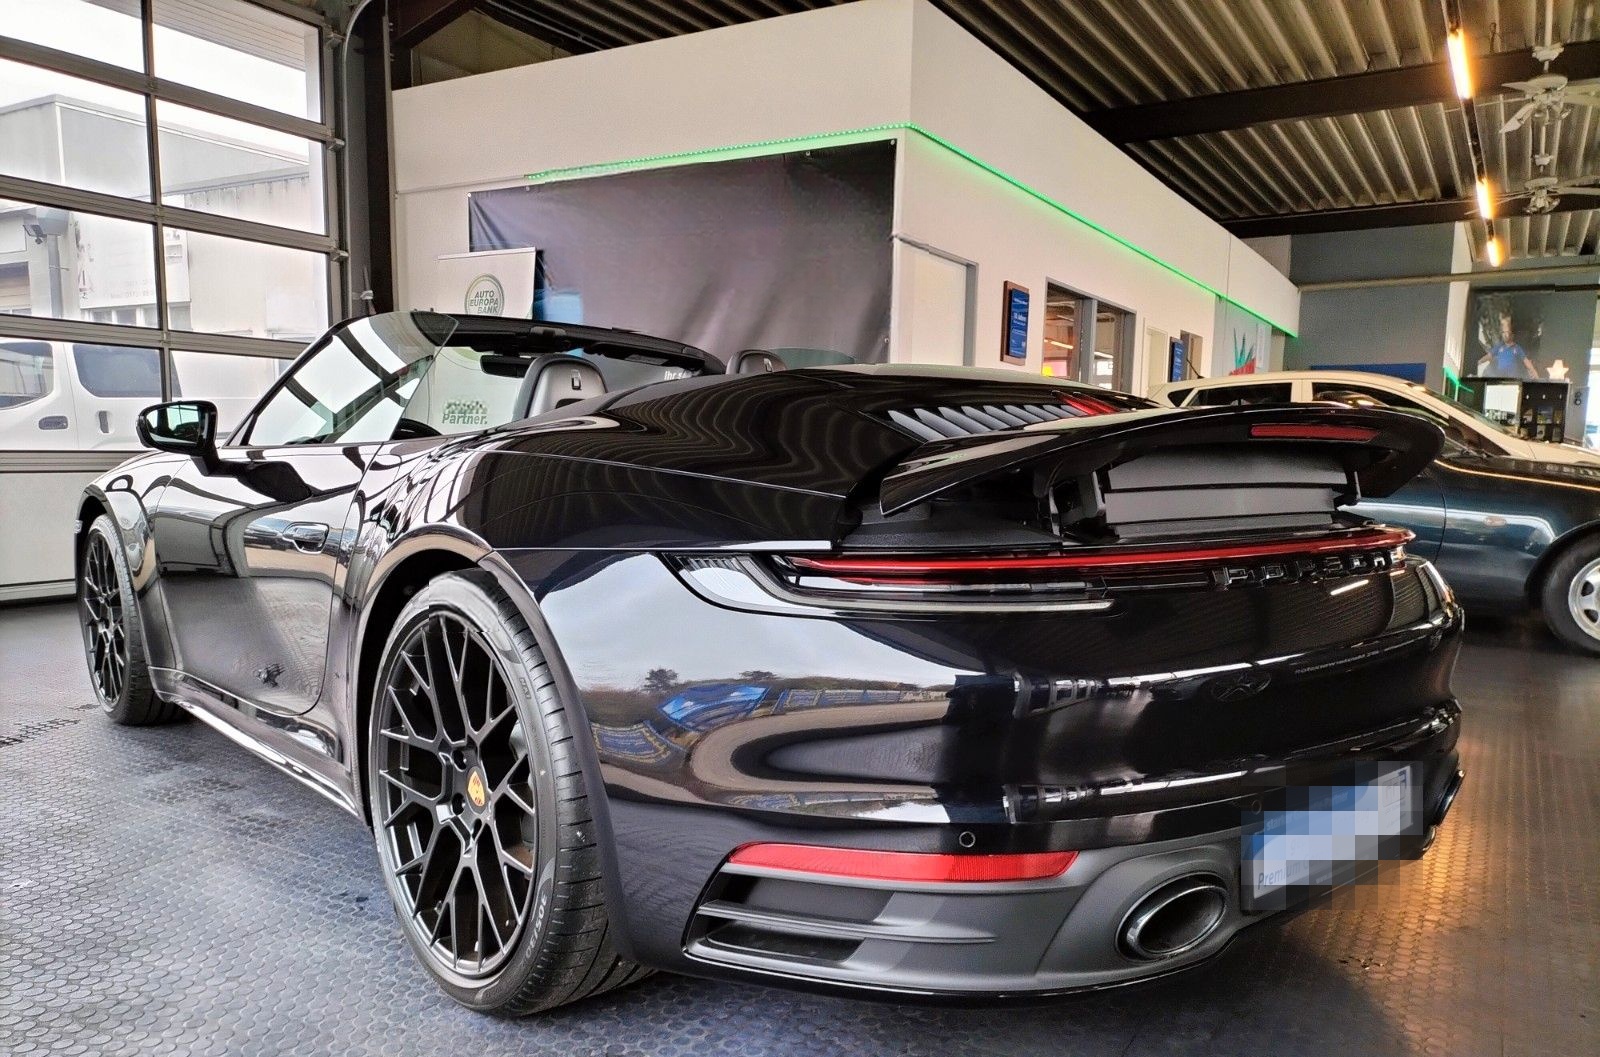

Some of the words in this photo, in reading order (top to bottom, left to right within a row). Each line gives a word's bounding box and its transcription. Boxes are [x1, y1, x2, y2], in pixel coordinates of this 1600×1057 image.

[474, 290, 495, 299] AUTO
[469, 298, 499, 307] EUROPA
[477, 306, 498, 315] BANK
[441, 413, 488, 425] Partner.
